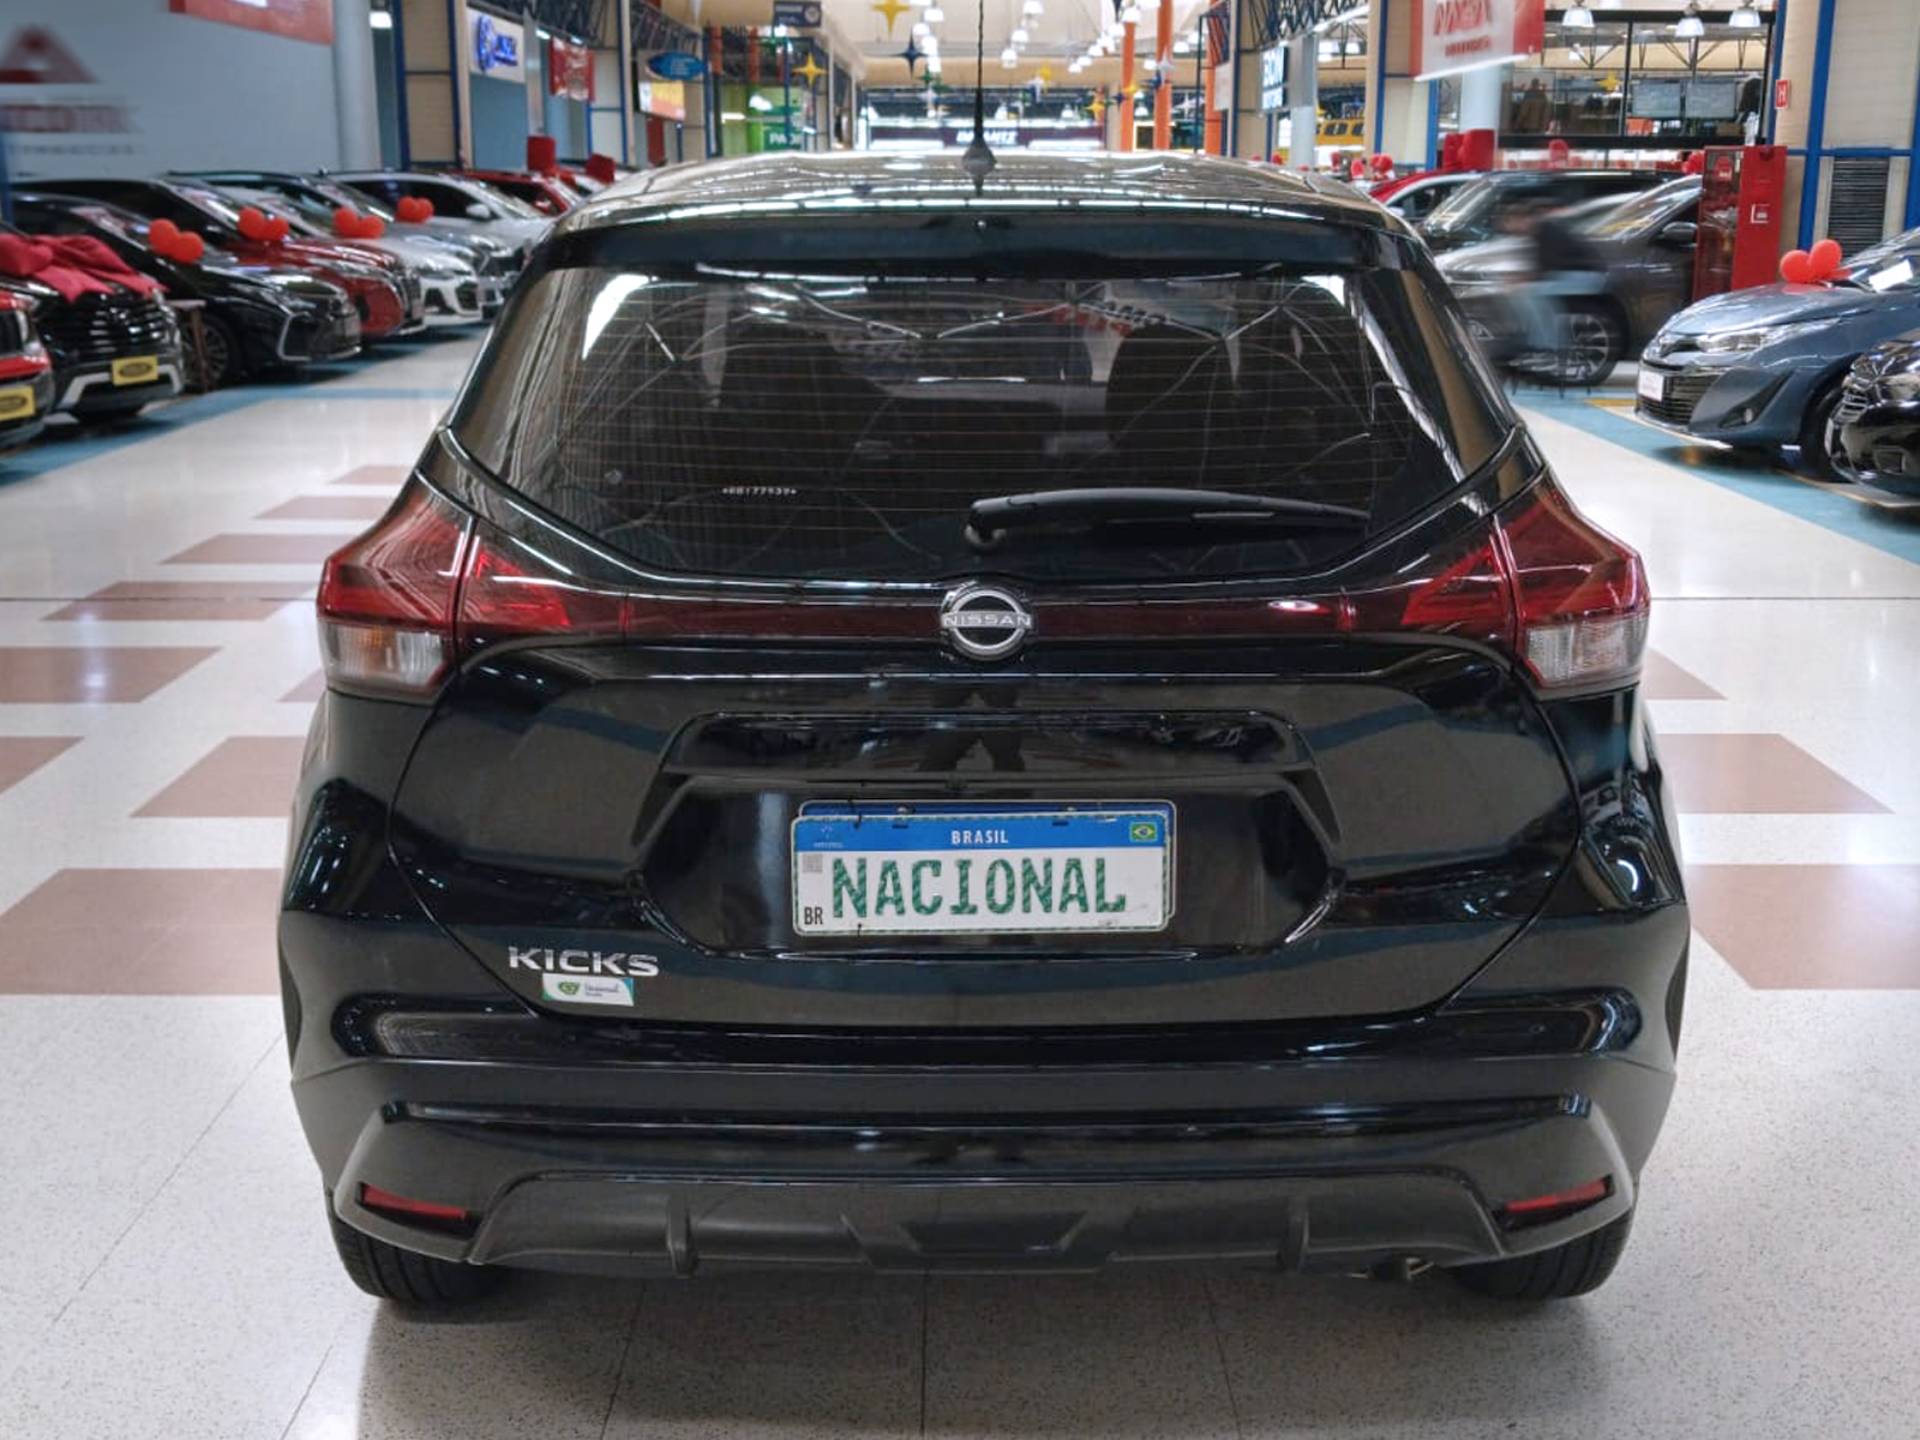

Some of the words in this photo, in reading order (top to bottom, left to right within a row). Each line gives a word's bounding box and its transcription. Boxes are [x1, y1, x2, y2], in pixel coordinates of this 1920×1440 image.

[943, 613, 1031, 627] NISSAN
[951, 829, 1008, 845] BRASIL
[832, 857, 1126, 918] NACIONAL
[804, 907, 823, 925] BR
[508, 946, 660, 977] KICKS
